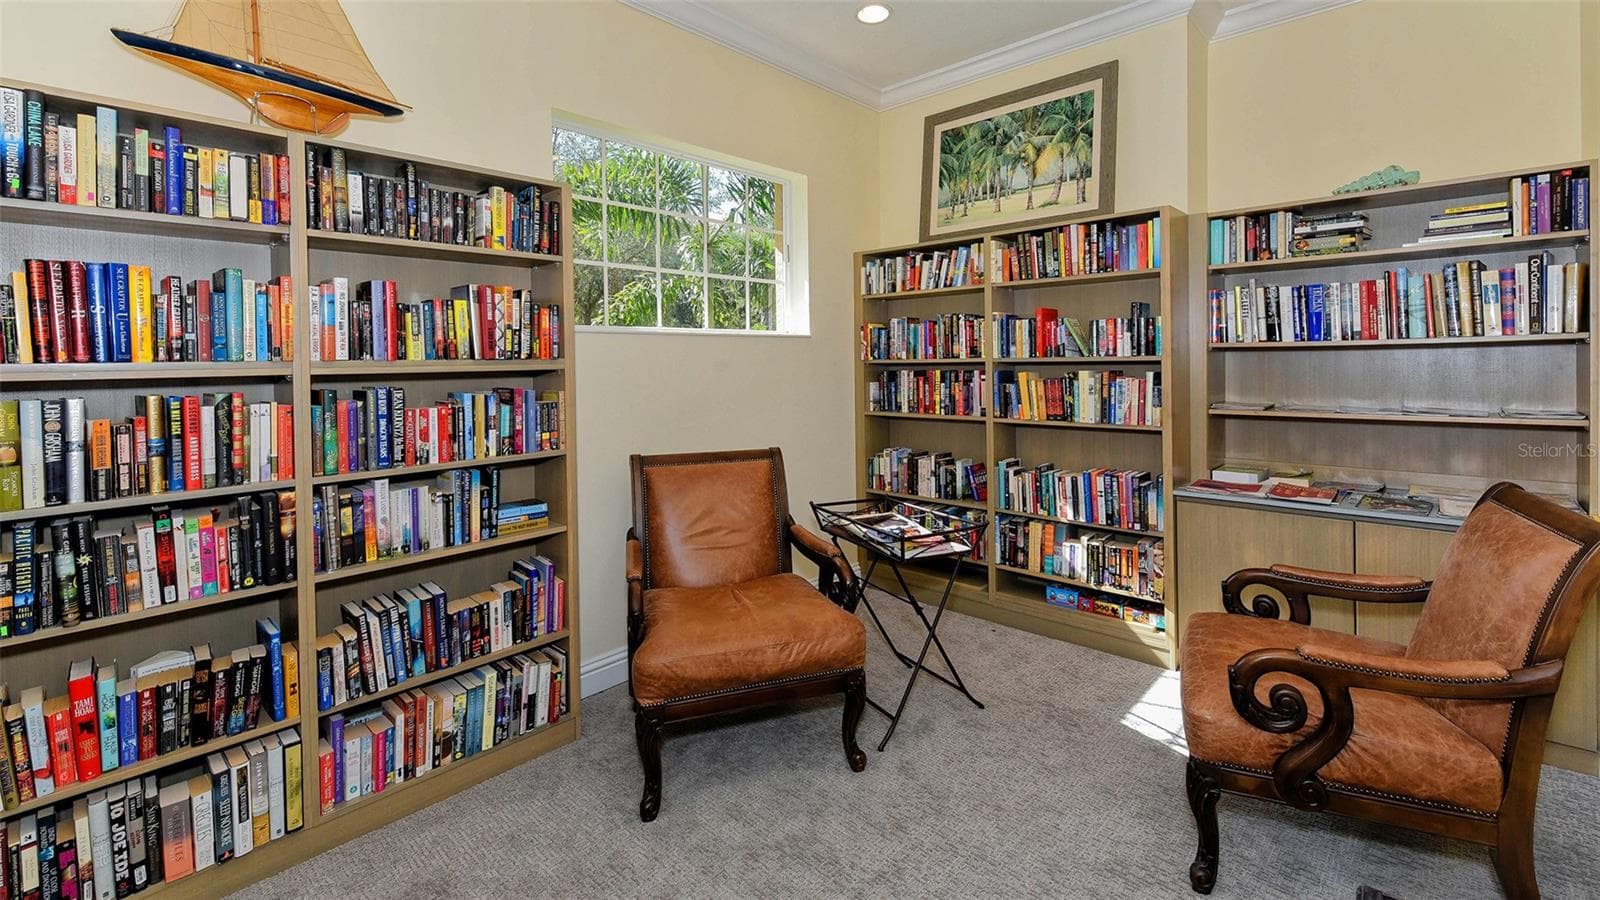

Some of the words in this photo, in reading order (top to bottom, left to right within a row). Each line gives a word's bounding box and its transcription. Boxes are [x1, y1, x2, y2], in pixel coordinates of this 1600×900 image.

[3, 92, 17, 105] LISA
[4, 105, 18, 133] GARDNER
[28, 101, 41, 125] CHINA
[28, 126, 41, 147] LAKE
[6, 143, 18, 166] TOUCH
[1531, 258, 1540, 272] Our
[54, 280, 65, 317] GRAFTON
[171, 278, 179, 307] HEATHER
[1531, 272, 1540, 303] Continent
[116, 312, 128, 321] U
[393, 390, 404, 409] DEAN
[44, 402, 61, 421] JOHN
[45, 432, 62, 463] GRISHAM
[15, 529, 31, 559] PACIFIC
[16, 562, 31, 594] HEIGHTS
[359, 615, 368, 633] DEXTER
[361, 640, 371, 658] DESIGN
[73, 695, 94, 709] TAMI
[74, 703, 95, 717] HOAG
[112, 823, 127, 851] JOE
[114, 851, 129, 881] IDE
